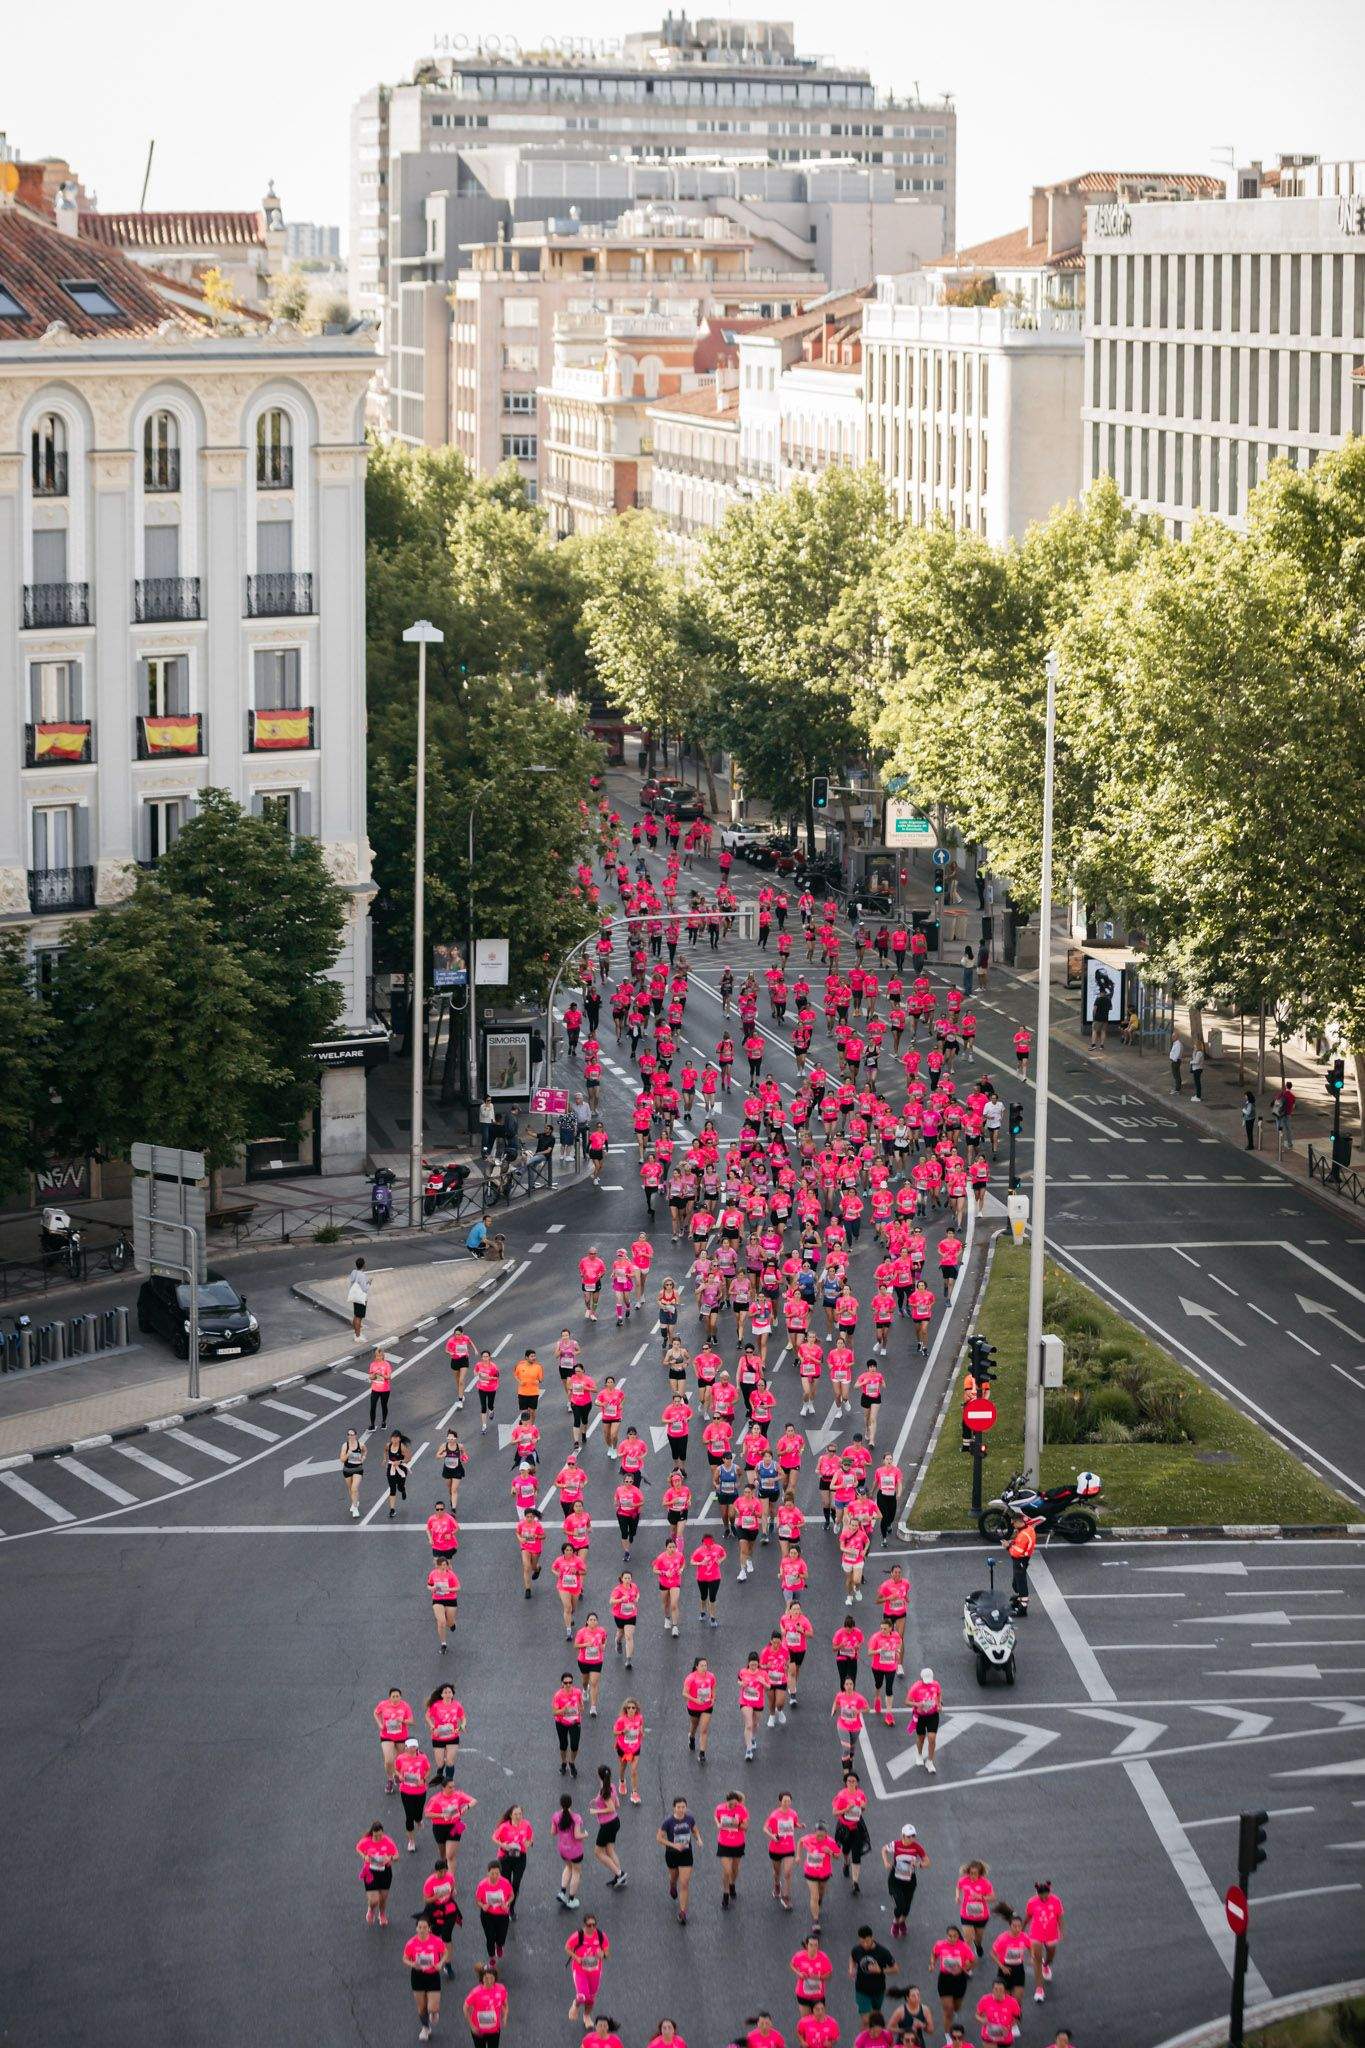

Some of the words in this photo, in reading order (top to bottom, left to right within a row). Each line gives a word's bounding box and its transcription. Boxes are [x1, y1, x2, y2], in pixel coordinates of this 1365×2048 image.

[488, 1036, 527, 1045] SIMORRA
[318, 1050, 364, 1060] WELFARE
[535, 1089, 550, 1099] Km
[536, 1098, 547, 1112] 3
[1073, 1094, 1146, 1106] TAXI
[1109, 1116, 1179, 1128] BUS
